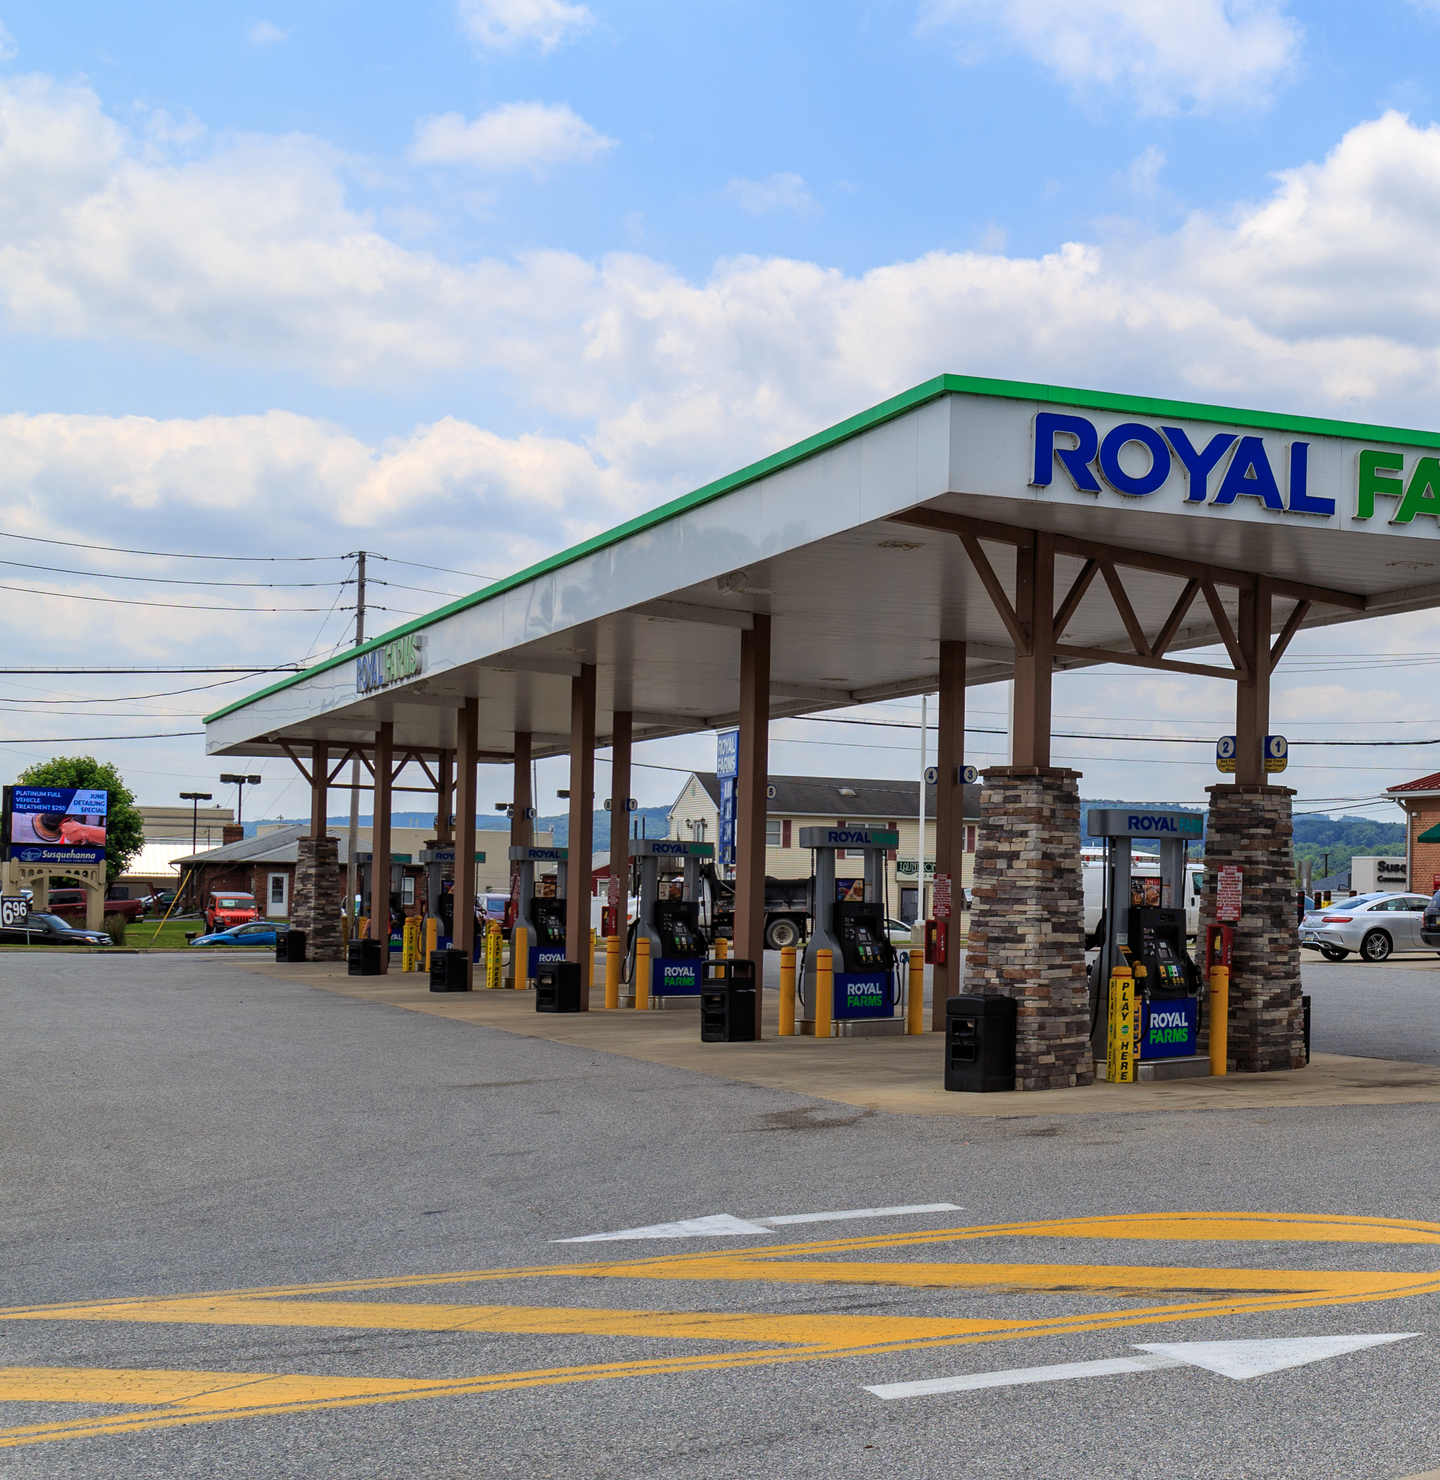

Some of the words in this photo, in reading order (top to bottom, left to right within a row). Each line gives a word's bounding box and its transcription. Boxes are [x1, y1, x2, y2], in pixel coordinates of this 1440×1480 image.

[1029, 411, 1336, 517] ROYAL
[357, 647, 384, 693] ROYAL
[384, 634, 421, 684] FARMS
[718, 736, 736, 756] ROYAL
[1222, 741, 1230, 754] 2
[1275, 740, 1281, 753] 1
[718, 755, 736, 775] FARMS
[928, 770, 934, 782] 4
[967, 769, 974, 781] 3
[769, 788, 773, 796] 5
[631, 800, 636, 809] 7
[1128, 815, 1178, 832] ROYAL
[828, 831, 872, 843] ROYAL
[528, 849, 561, 859] ROYAL
[652, 843, 689, 854] ROYAL
[42, 849, 96, 863] Susquehanna
[539, 953, 566, 962] ROYAL
[664, 966, 696, 977] ROYAL
[664, 976, 695, 986] FARMS
[847, 982, 883, 996] ROYAL
[847, 995, 882, 1008] FARMS
[1121, 982, 1130, 1021] PLAY
[1149, 1011, 1189, 1028] ROYAL
[1132, 1006, 1140, 1054] DESEL
[1149, 1027, 1189, 1044] FARMS
[1120, 1041, 1129, 1080] HERE
